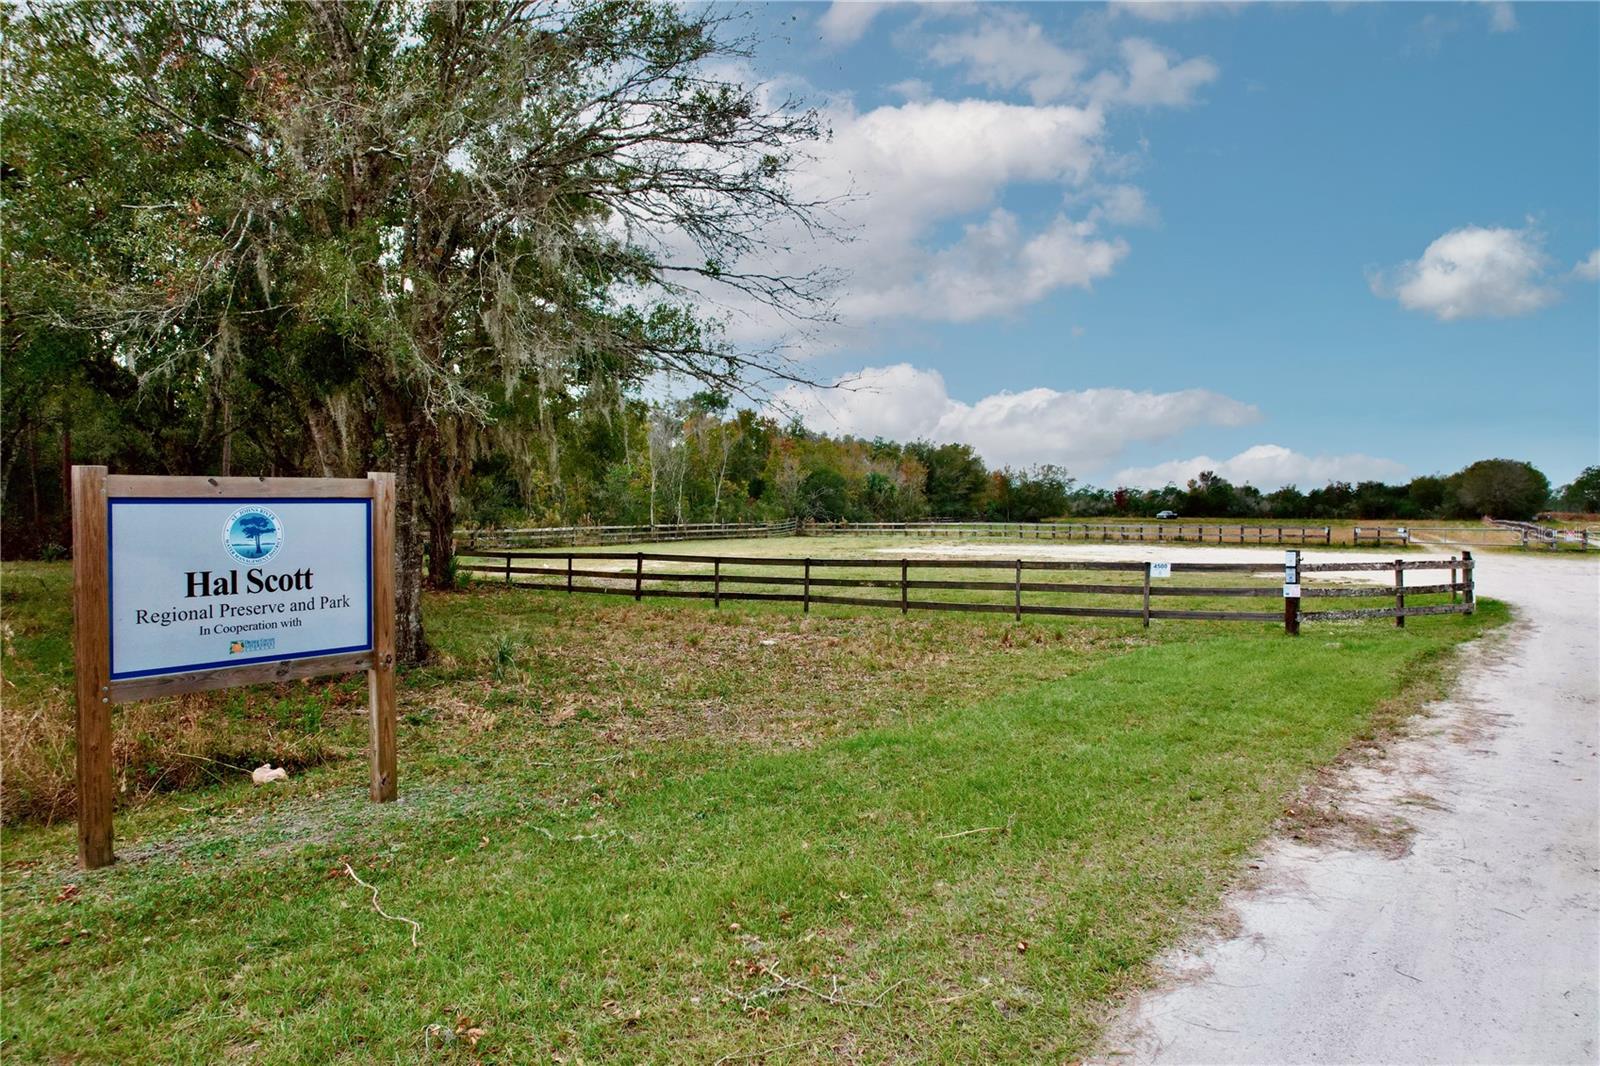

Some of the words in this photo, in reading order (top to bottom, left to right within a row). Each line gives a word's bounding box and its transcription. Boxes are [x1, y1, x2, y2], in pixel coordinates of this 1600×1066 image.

[184, 569, 239, 599] Hal
[246, 567, 314, 595] Scott
[136, 604, 214, 627] Regional
[220, 601, 286, 618] Preserve
[290, 597, 315, 612] and
[320, 595, 350, 610] Park
[199, 625, 211, 636] In
[213, 619, 278, 635] Cooperation
[280, 617, 303, 629] with
